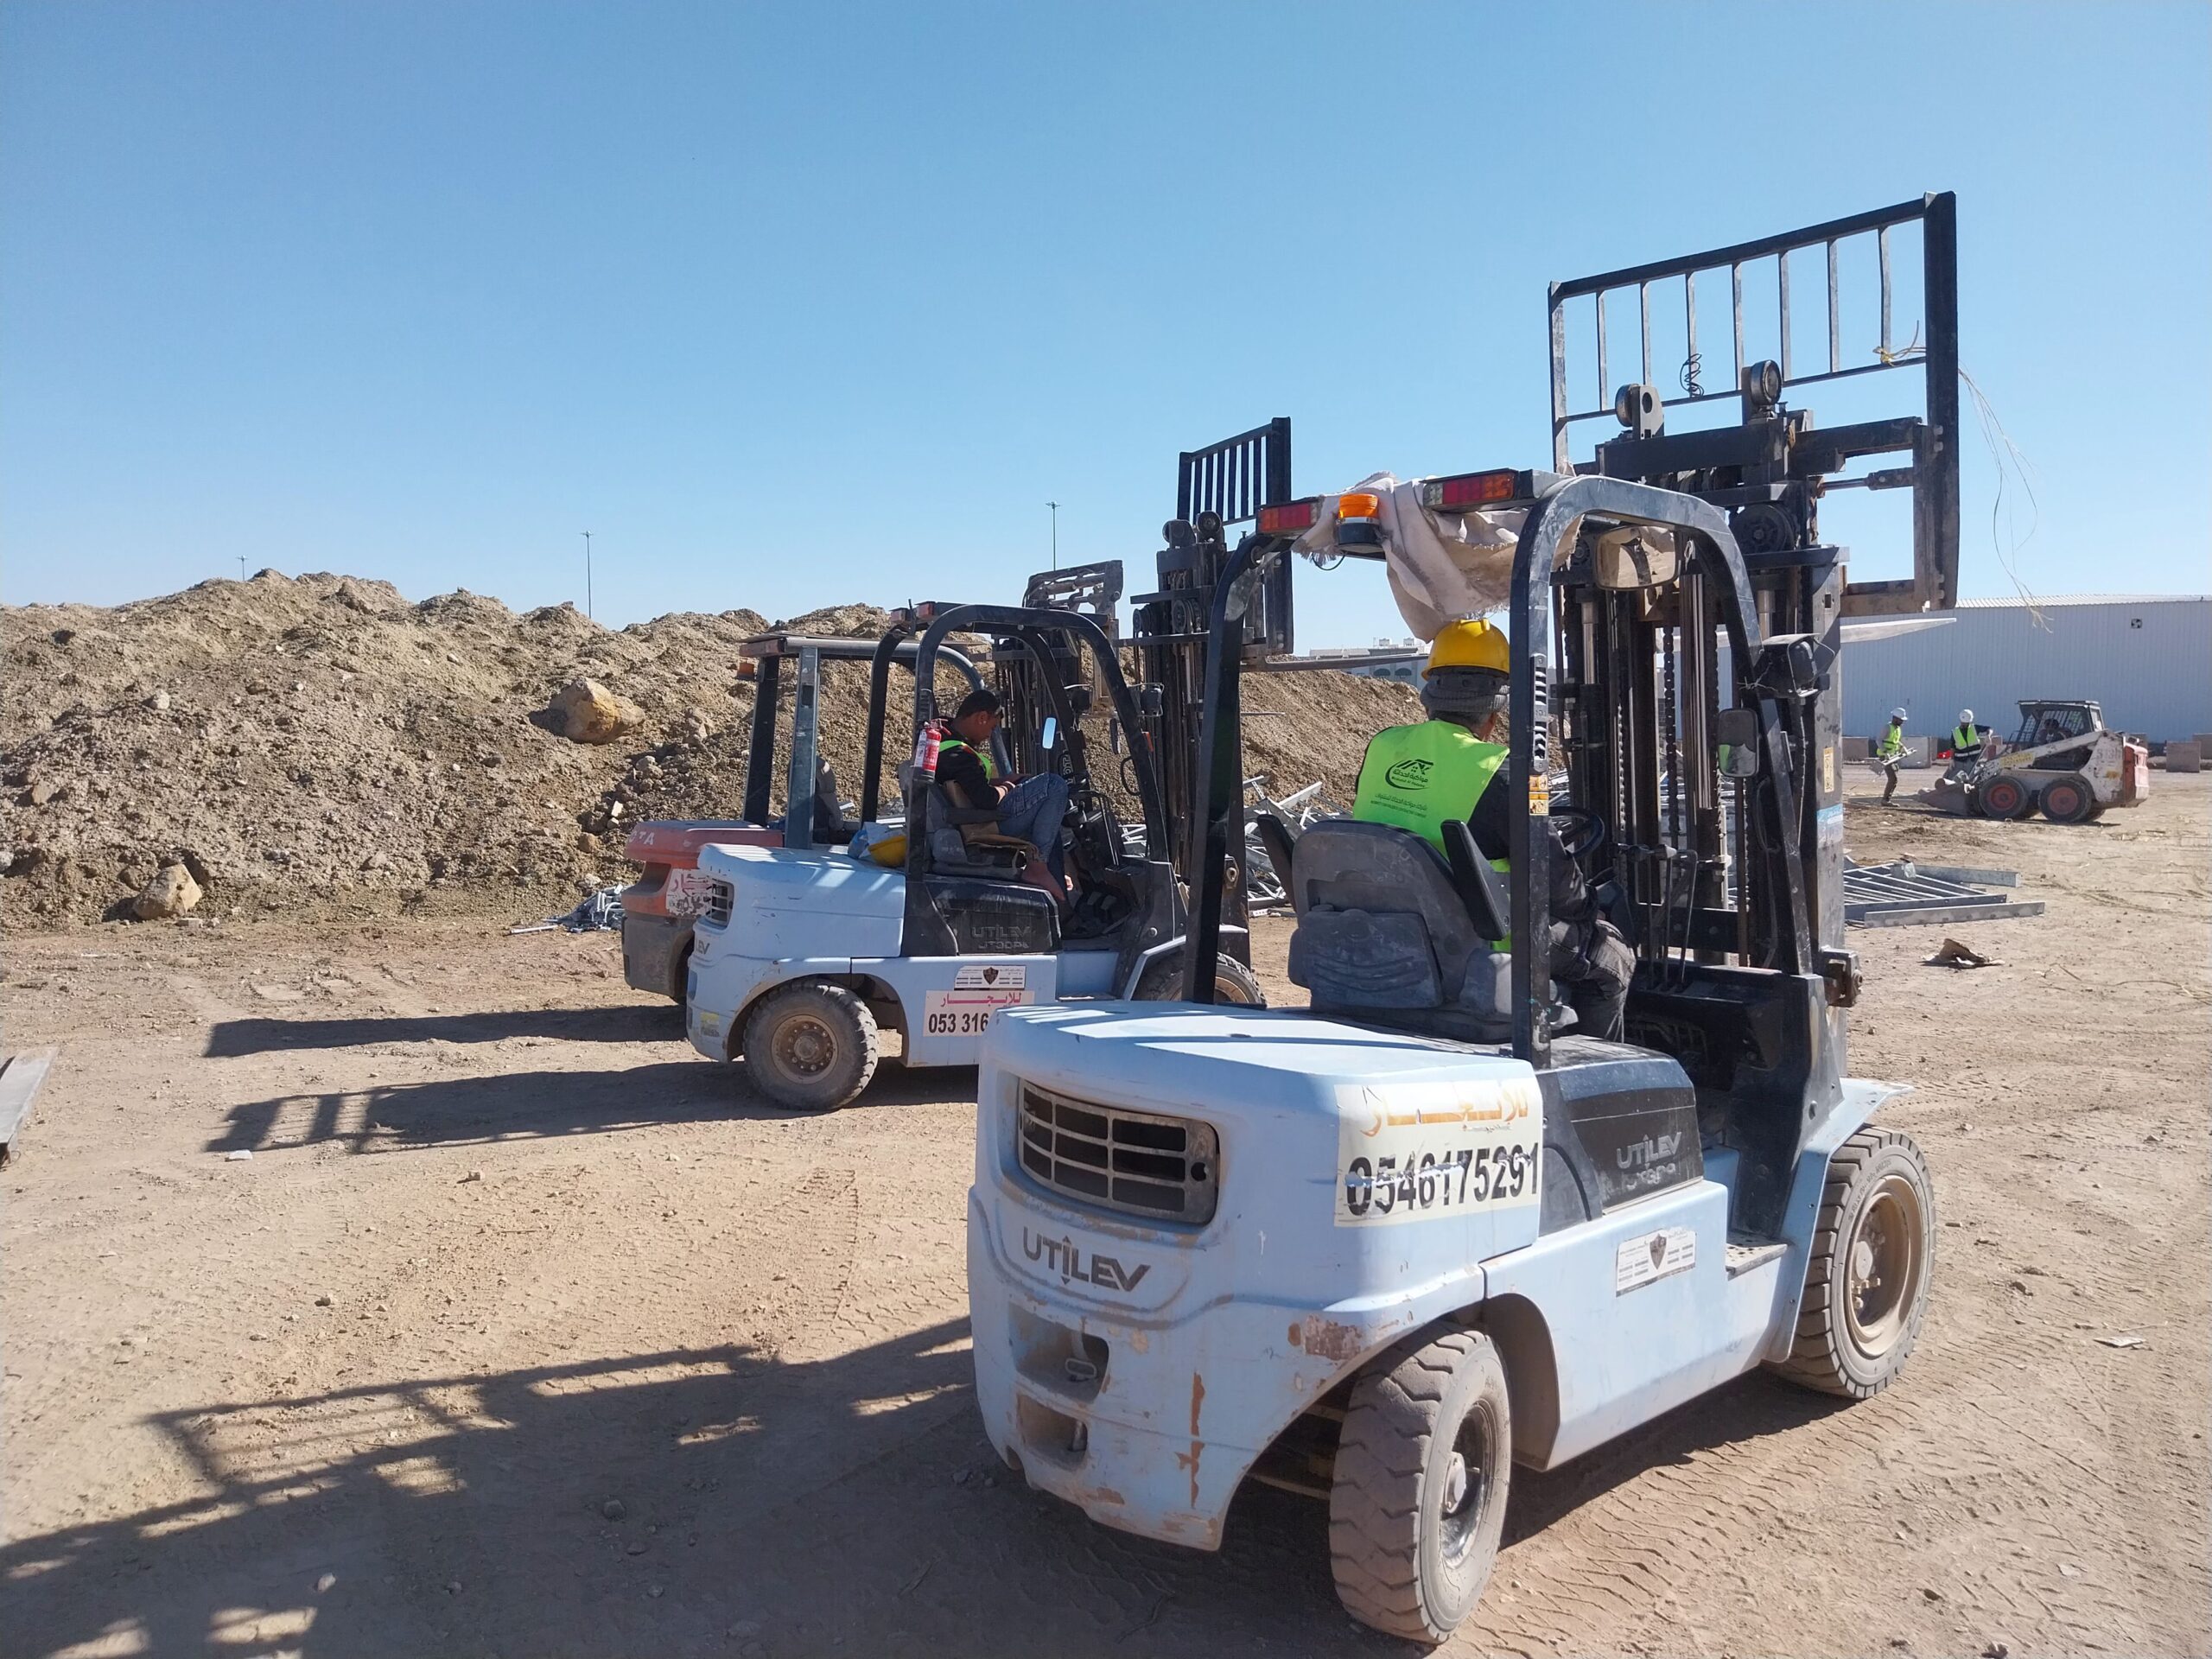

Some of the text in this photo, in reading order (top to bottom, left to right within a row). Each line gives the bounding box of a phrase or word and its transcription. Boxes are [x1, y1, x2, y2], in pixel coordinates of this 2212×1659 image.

[928, 1014, 957, 1033] 053
[1616, 1131, 1682, 1170] UTILEV
[1023, 1226, 1151, 1292] UTILEV
